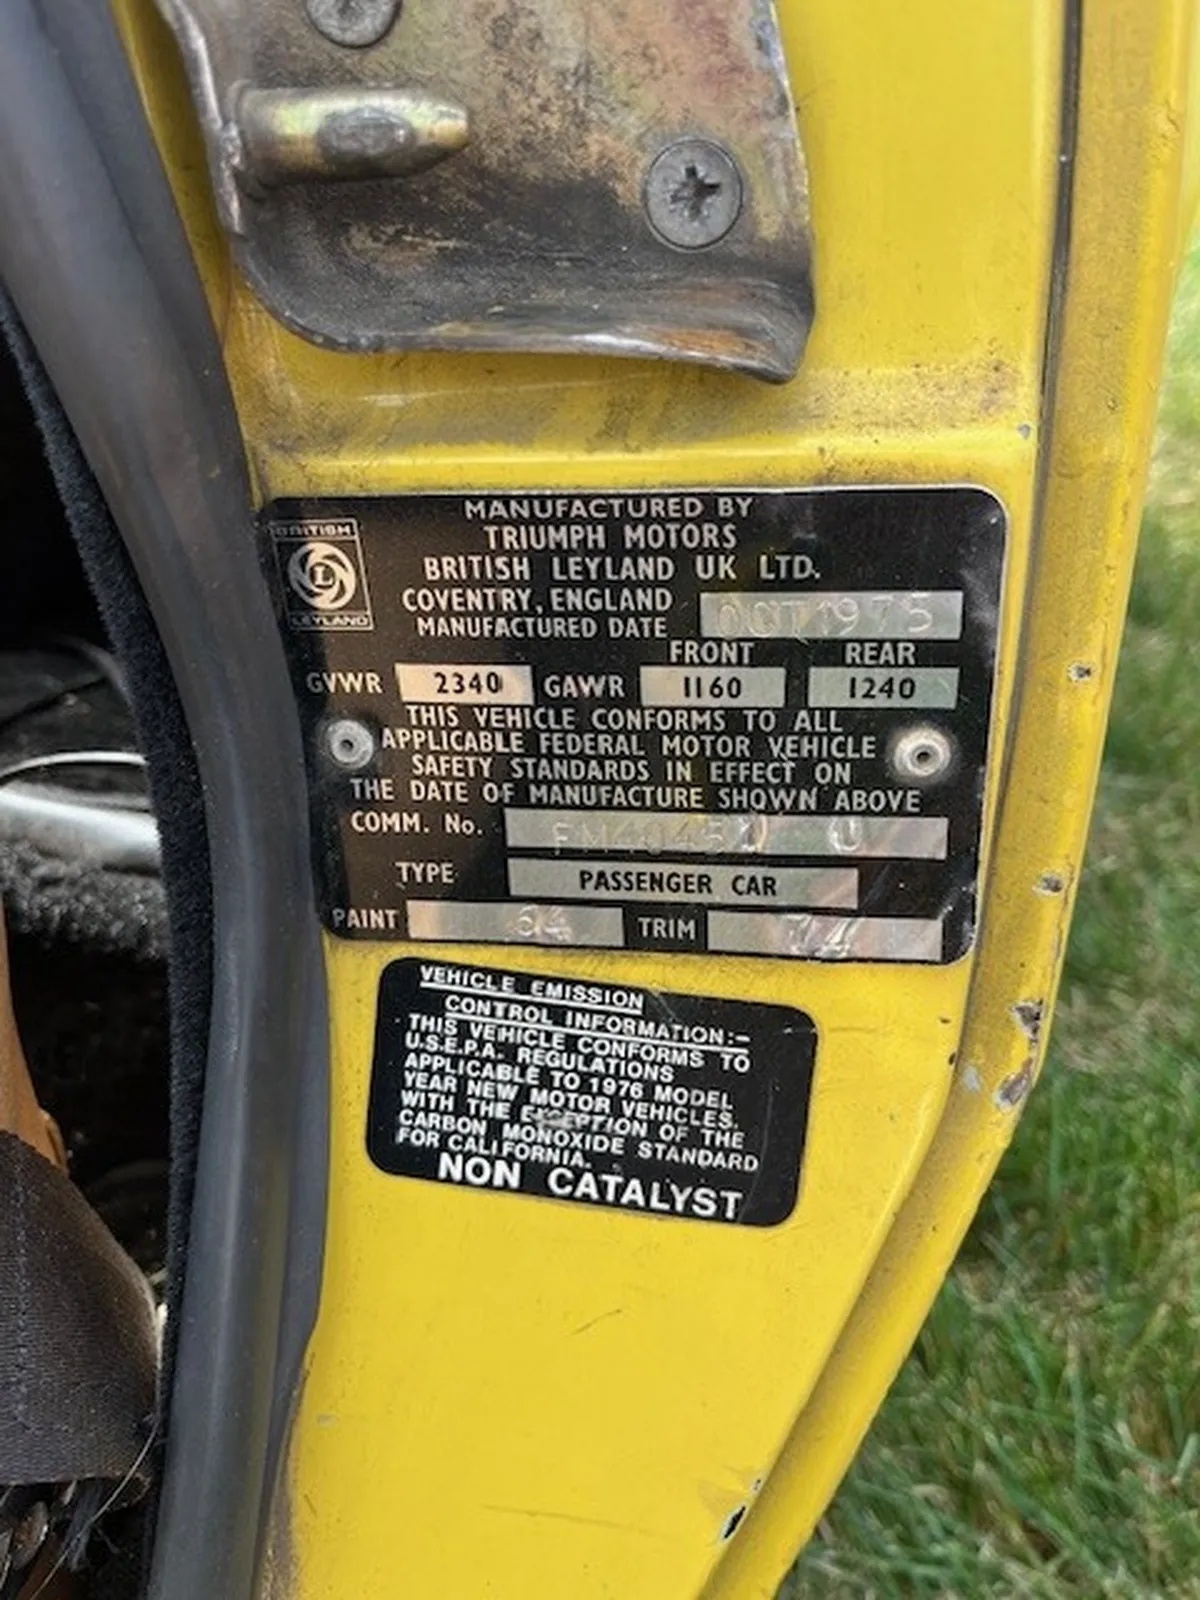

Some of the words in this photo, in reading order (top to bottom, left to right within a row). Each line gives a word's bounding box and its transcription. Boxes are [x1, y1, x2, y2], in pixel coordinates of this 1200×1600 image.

[465, 498, 702, 519] MANUFACTURED
[719, 497, 752, 517] BY
[484, 524, 605, 550] TRIUMPH
[624, 523, 737, 549] MOTORS
[425, 557, 530, 581] BRITISH
[552, 556, 674, 581] LEYLAND
[696, 555, 737, 580] UK
[760, 555, 821, 580] LTD.
[402, 588, 543, 615] COVENTRY,
[551, 588, 672, 612] ENGLAND
[417, 617, 597, 638] MANUFACTURED
[609, 617, 667, 638] DATE
[670, 642, 754, 664] FRONT
[845, 642, 916, 665] REAR
[307, 672, 382, 694] GVWR
[435, 672, 502, 694] 2340
[544, 674, 625, 698] GAWR
[683, 676, 742, 699] 1160
[849, 676, 916, 699] 1240
[406, 705, 458, 727] THIS
[473, 707, 574, 730] VEHICLE
[592, 708, 726, 731] CONFORMS
[745, 710, 776, 732] TO
[795, 710, 843, 732] ALL
[381, 727, 524, 752] APPLICABLE
[540, 731, 645, 756] FEDERAL
[661, 735, 750, 757] MOTOR
[768, 736, 876, 759] VEHICLE
[412, 753, 492, 777] SAFETY
[511, 757, 649, 780] STANDARDS
[667, 760, 692, 781] IN
[710, 761, 795, 784] EFFECT
[815, 762, 851, 784] ON
[351, 778, 394, 800] THE
[411, 780, 468, 802] DATE
[483, 783, 515, 803] OF
[530, 784, 703, 809] MANUFACTURE
[719, 788, 817, 811] SHOWN
[835, 788, 921, 812] ABOVE
[351, 811, 429, 834] COMM.
[445, 814, 483, 835] No.
[396, 861, 454, 884] TYPE
[579, 870, 712, 894] PASSENGER
[731, 875, 777, 896] CAR
[332, 908, 398, 930] PAINT
[638, 916, 696, 940] TRIM
[420, 965, 515, 992] VEHICLE
[531, 980, 643, 1008] EMISSION
[445, 995, 553, 1024] CONTROL
[405, 1032, 504, 1059] U.S.E.P.A.
[517, 1047, 674, 1082] REGULATIONS
[408, 1013, 457, 1036] THIS
[470, 1022, 565, 1049] VEHICLE
[578, 1036, 704, 1067] CONFORMS
[721, 1054, 750, 1073] TO
[404, 1053, 540, 1084] APPLICABLE
[551, 1071, 580, 1090] TO
[590, 1077, 643, 1098] 1976
[654, 1085, 733, 1109] MODEL
[404, 1071, 457, 1092] YEAR
[467, 1080, 518, 1100] NEW
[530, 1088, 610, 1113] MOTOR
[622, 1100, 738, 1129] VEHICLES.
[402, 1090, 454, 1111] WITH
[466, 1099, 510, 1119] THE
[659, 1124, 688, 1141] OF
[701, 1129, 744, 1149] THE
[396, 1128, 440, 1148] FOR
[448, 1135, 592, 1168] CALIFORNIA.
[400, 1110, 487, 1135] CARBON
[502, 1123, 625, 1155] MONOXIDE
[638, 1142, 759, 1171] STANDARD
[438, 1152, 521, 1188] NON
[548, 1167, 742, 1220] CATALYST
